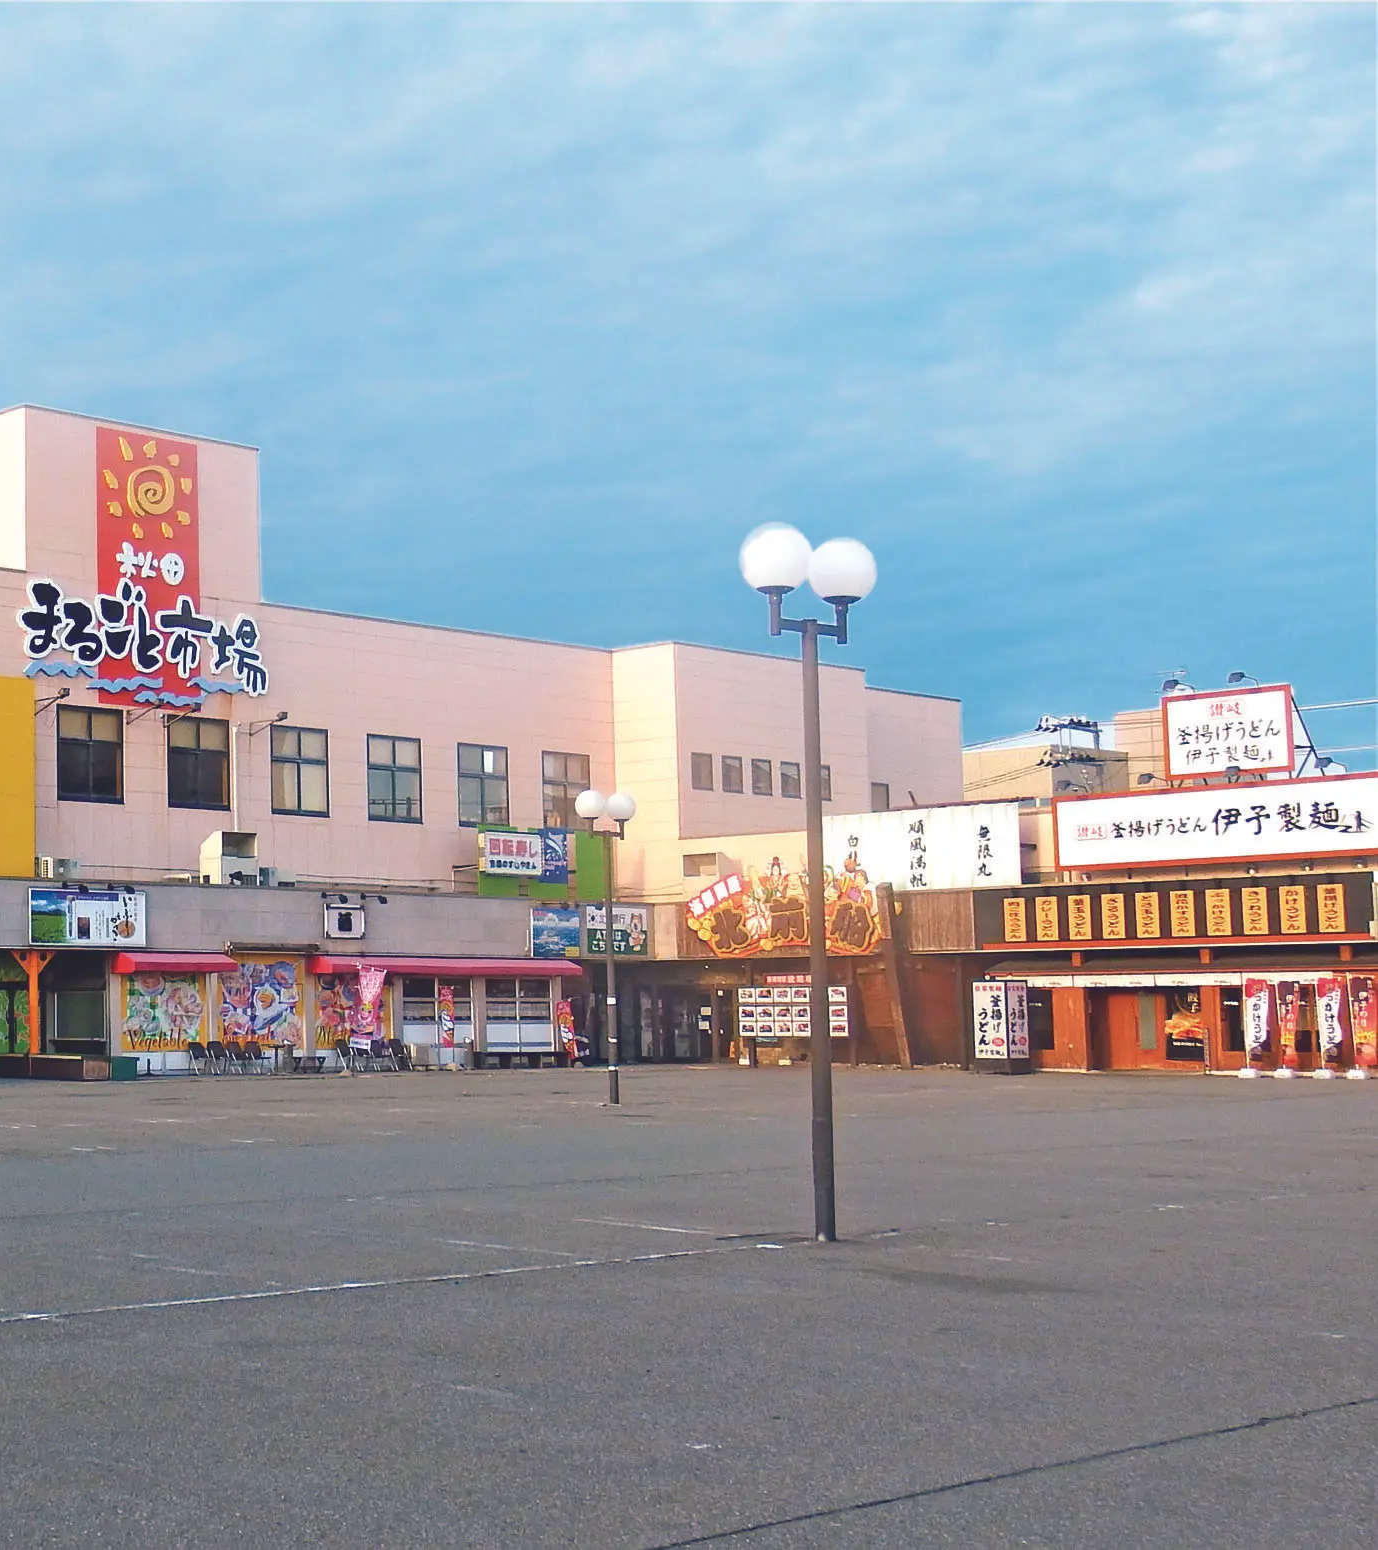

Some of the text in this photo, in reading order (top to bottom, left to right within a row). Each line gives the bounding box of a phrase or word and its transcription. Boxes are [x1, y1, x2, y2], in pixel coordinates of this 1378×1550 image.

[116, 541, 185, 586] 秋田
[17, 577, 269, 696] まるごと市場
[1176, 719, 1281, 746] 釜揚げうどん
[1186, 744, 1260, 766] 伊予製麺
[1110, 816, 1207, 839] 釜揚げうどん
[1211, 801, 1340, 836] 伊予製麺
[489, 837, 538, 858] 回転寿し
[977, 825, 994, 877] 無限丸
[710, 896, 872, 951] 北前船
[1041, 900, 1054, 939] カレーうどん
[1073, 898, 1087, 937] 釜玉うどん
[1106, 897, 1120, 937] ざるうどん
[1247, 890, 1262, 932] きつねうどん
[1285, 889, 1300, 931] かけうどん
[592, 940, 626, 952] こちです
[596, 930, 622, 941] ATは
[978, 1007, 990, 1046] うどん
[990, 994, 1003, 1034] 釜揚げ
[124, 1027, 189, 1051] Vegetable
